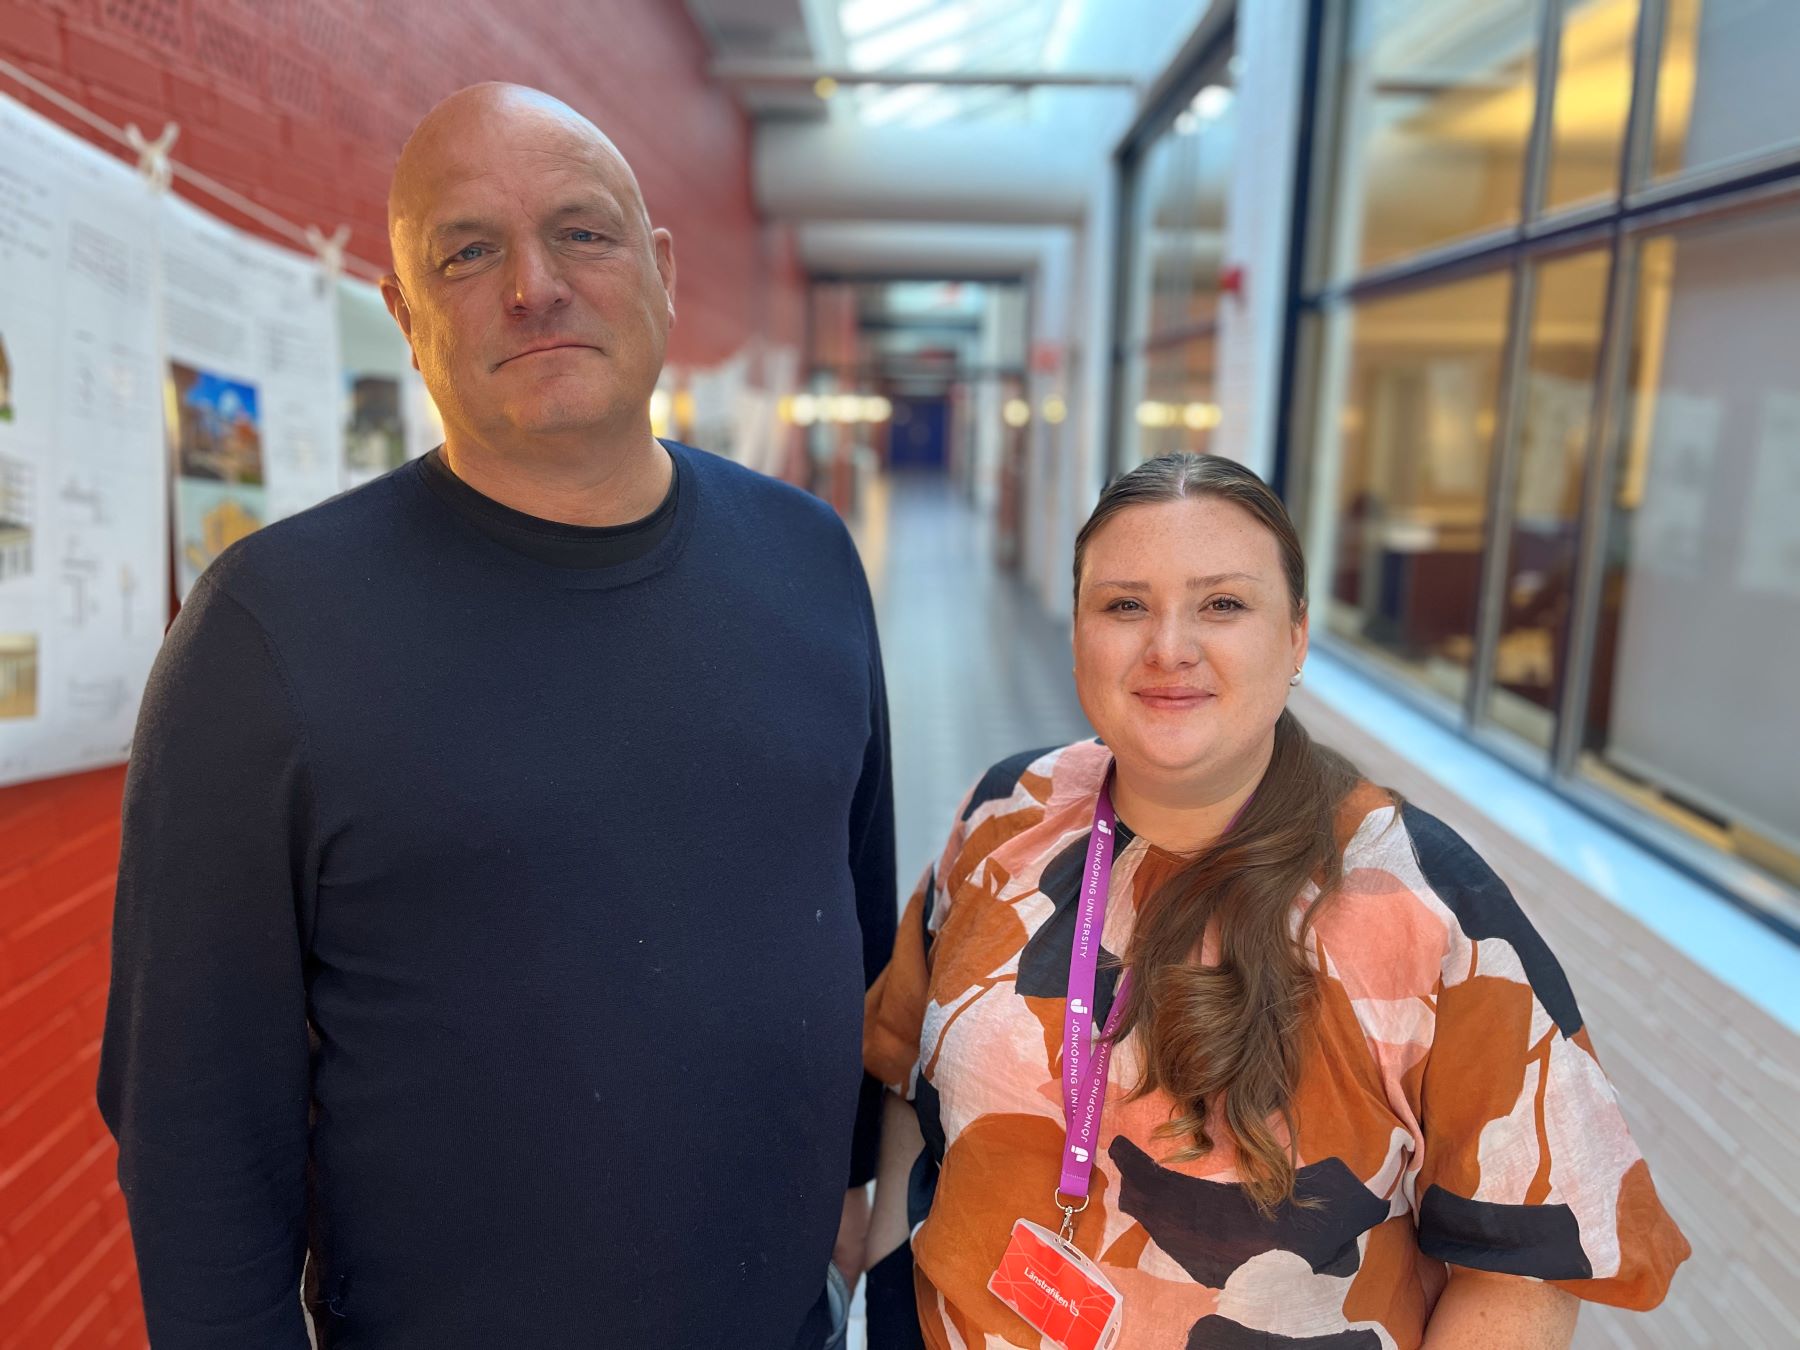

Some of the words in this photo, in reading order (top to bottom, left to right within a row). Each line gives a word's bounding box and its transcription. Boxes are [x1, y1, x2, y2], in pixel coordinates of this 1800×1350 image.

[1088, 837, 1104, 895] JÖNKÖPING
[1080, 898, 1095, 958] UNIVERSITY
[1070, 1019, 1080, 1084] JÖNKÖPING
[1080, 1078, 1101, 1143] JÖNKÖPING
[1024, 1267, 1069, 1308] Länstrafiken
